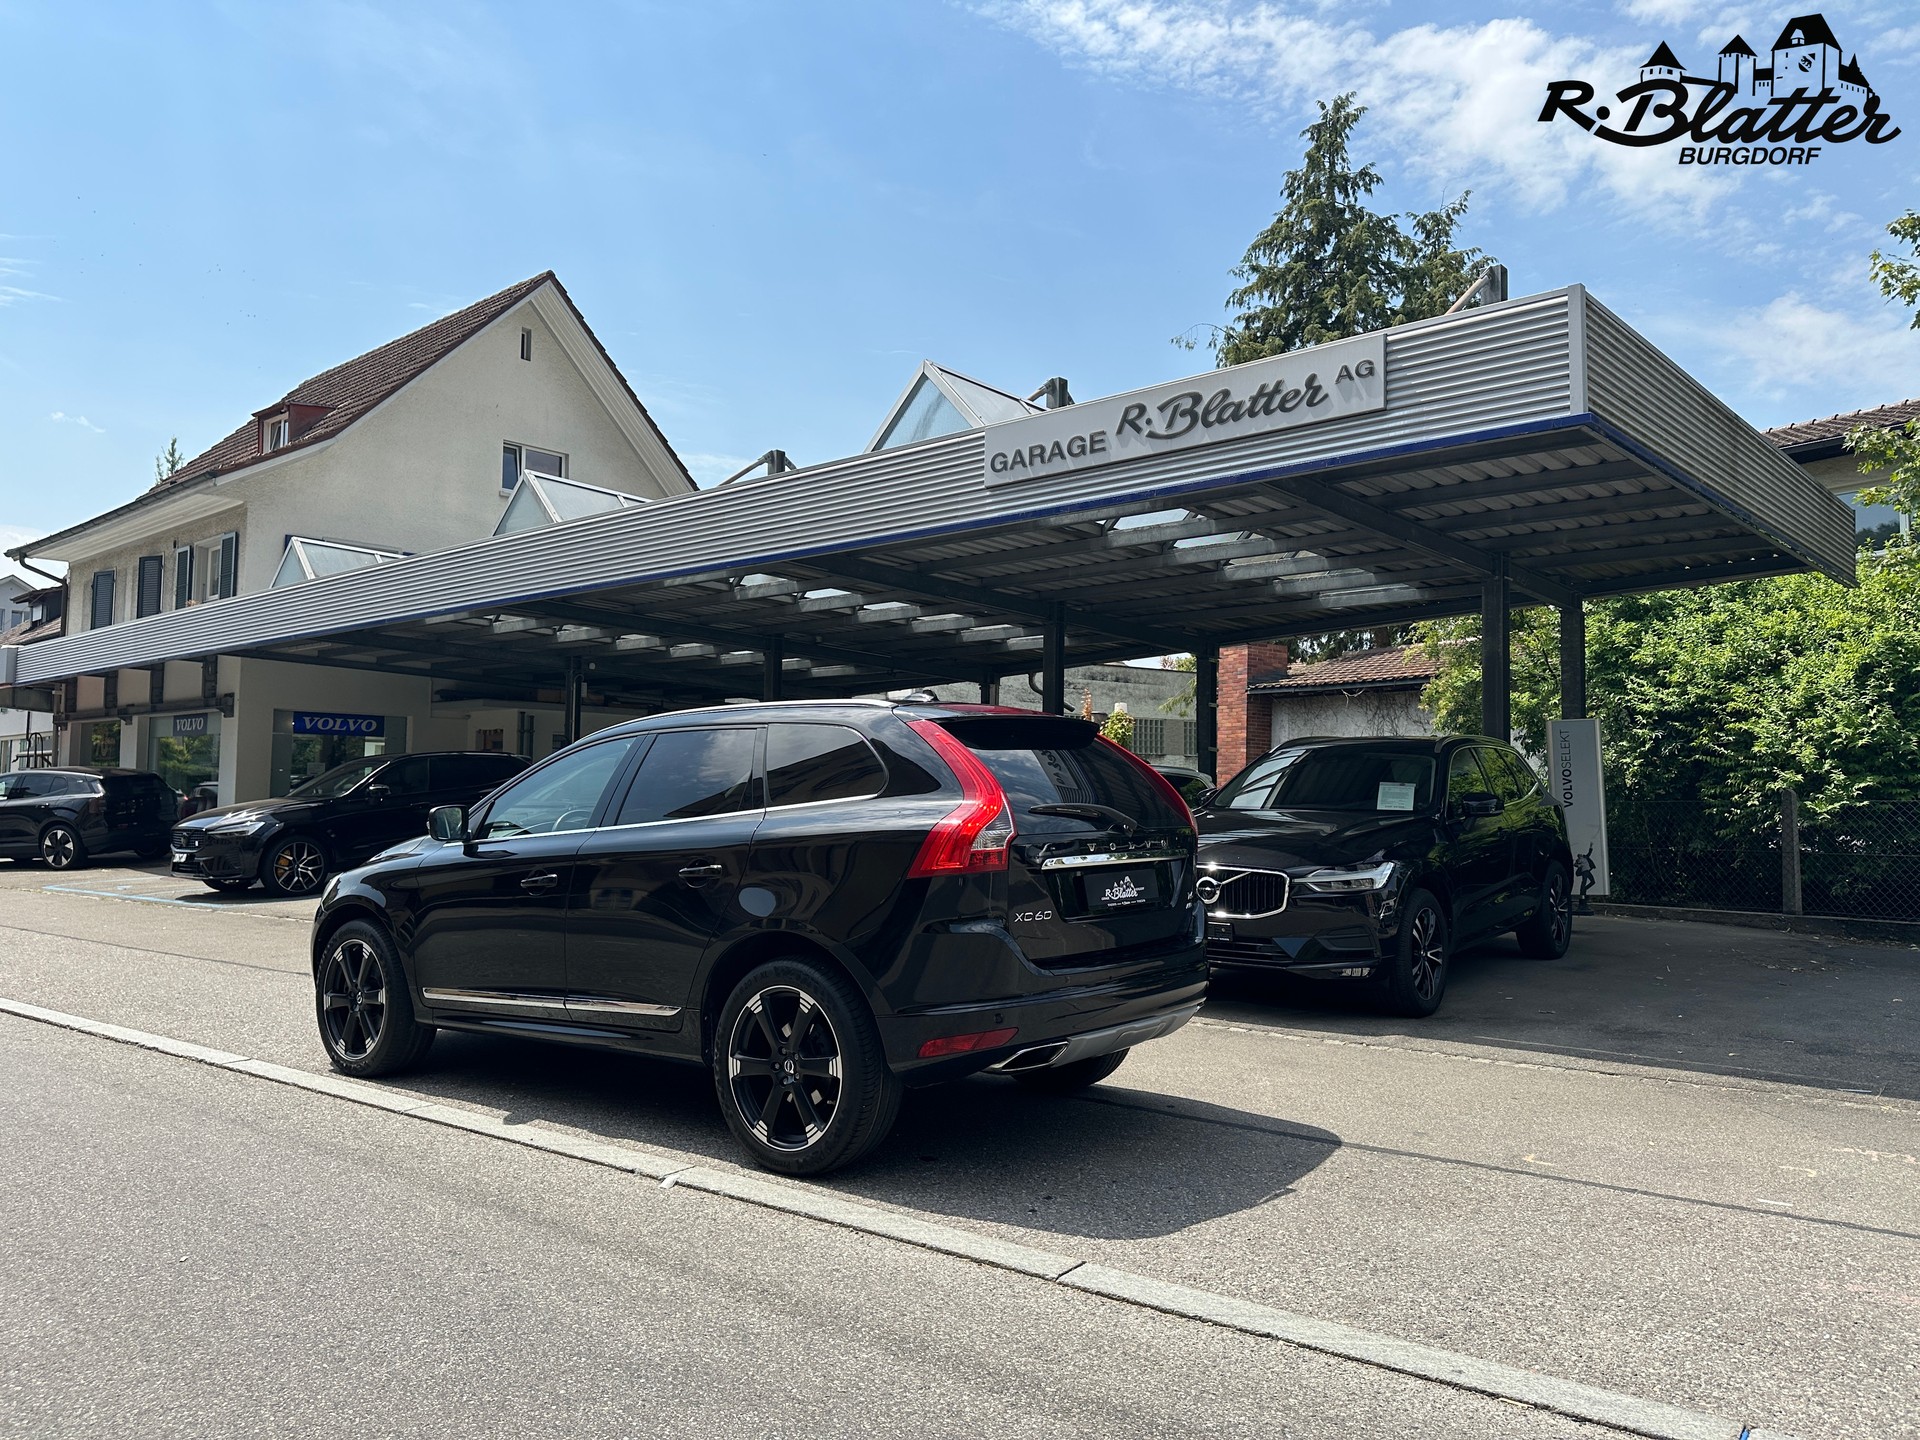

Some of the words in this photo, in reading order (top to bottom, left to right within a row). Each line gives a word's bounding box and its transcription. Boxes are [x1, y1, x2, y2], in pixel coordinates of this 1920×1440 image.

[989, 429, 1107, 474] GARAGE
[1335, 358, 1376, 385] AG
[175, 717, 204, 732] VOLVO
[302, 715, 378, 732] VOLVO
[1086, 839, 1167, 852] VOLVO
[1014, 910, 1053, 923] XC60
